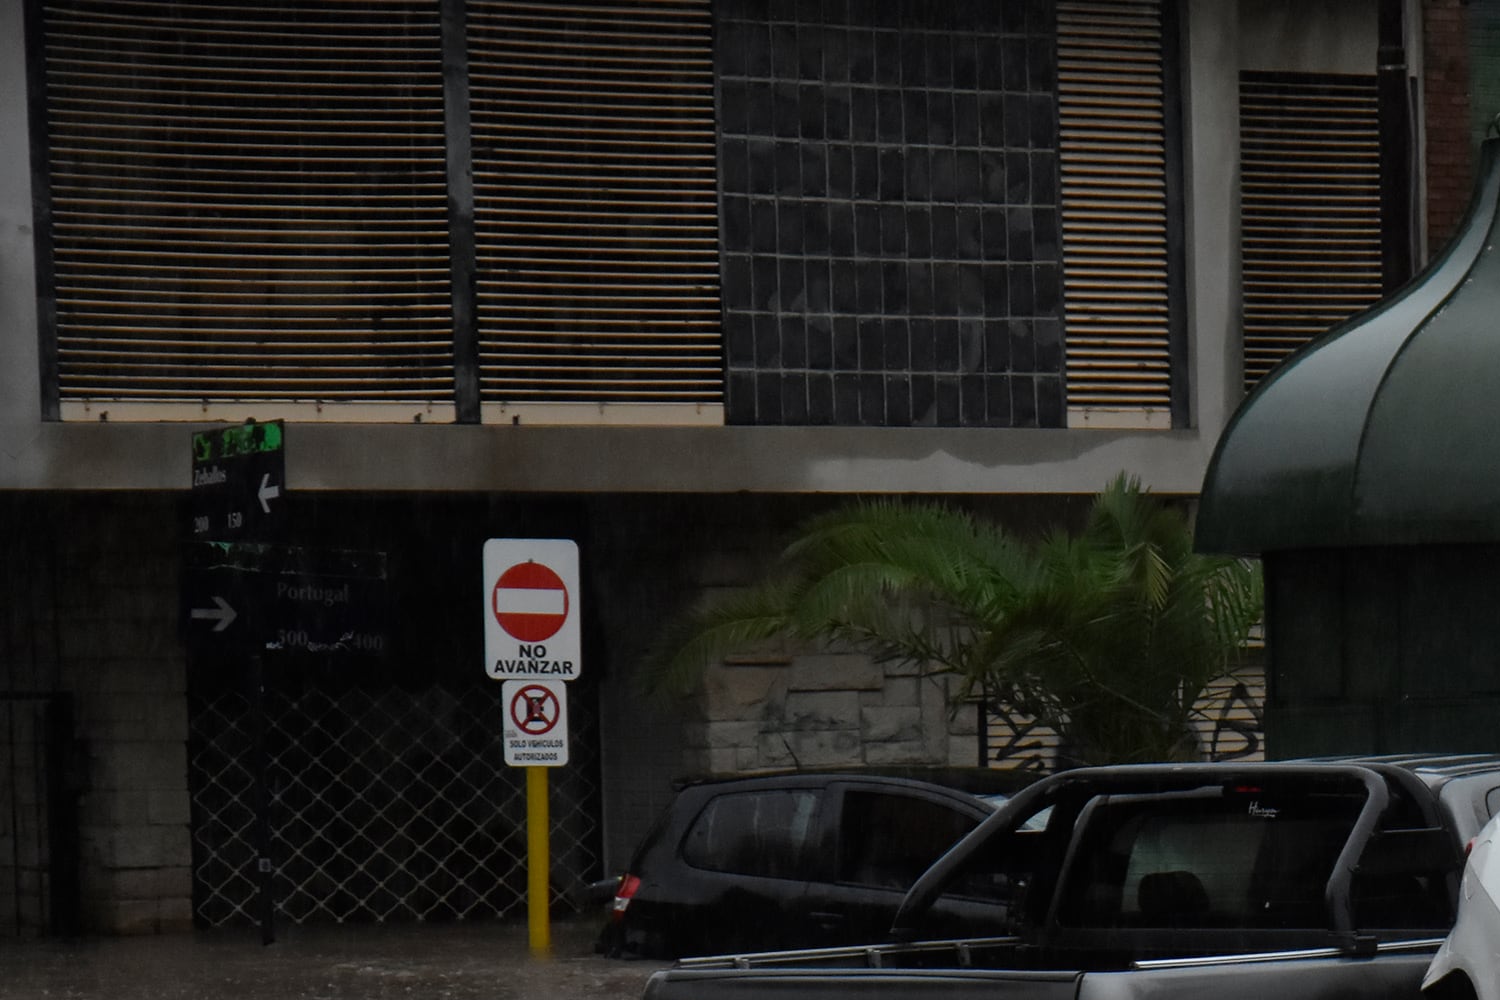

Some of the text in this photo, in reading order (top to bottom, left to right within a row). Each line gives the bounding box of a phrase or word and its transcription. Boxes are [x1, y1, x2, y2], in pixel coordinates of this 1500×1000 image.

[276, 582, 350, 607] Portugal
[519, 644, 547, 659] NO
[494, 660, 574, 675] AVANZAR
[509, 739, 526, 749] SOLO
[513, 752, 558, 761] AUTORIZADOS
